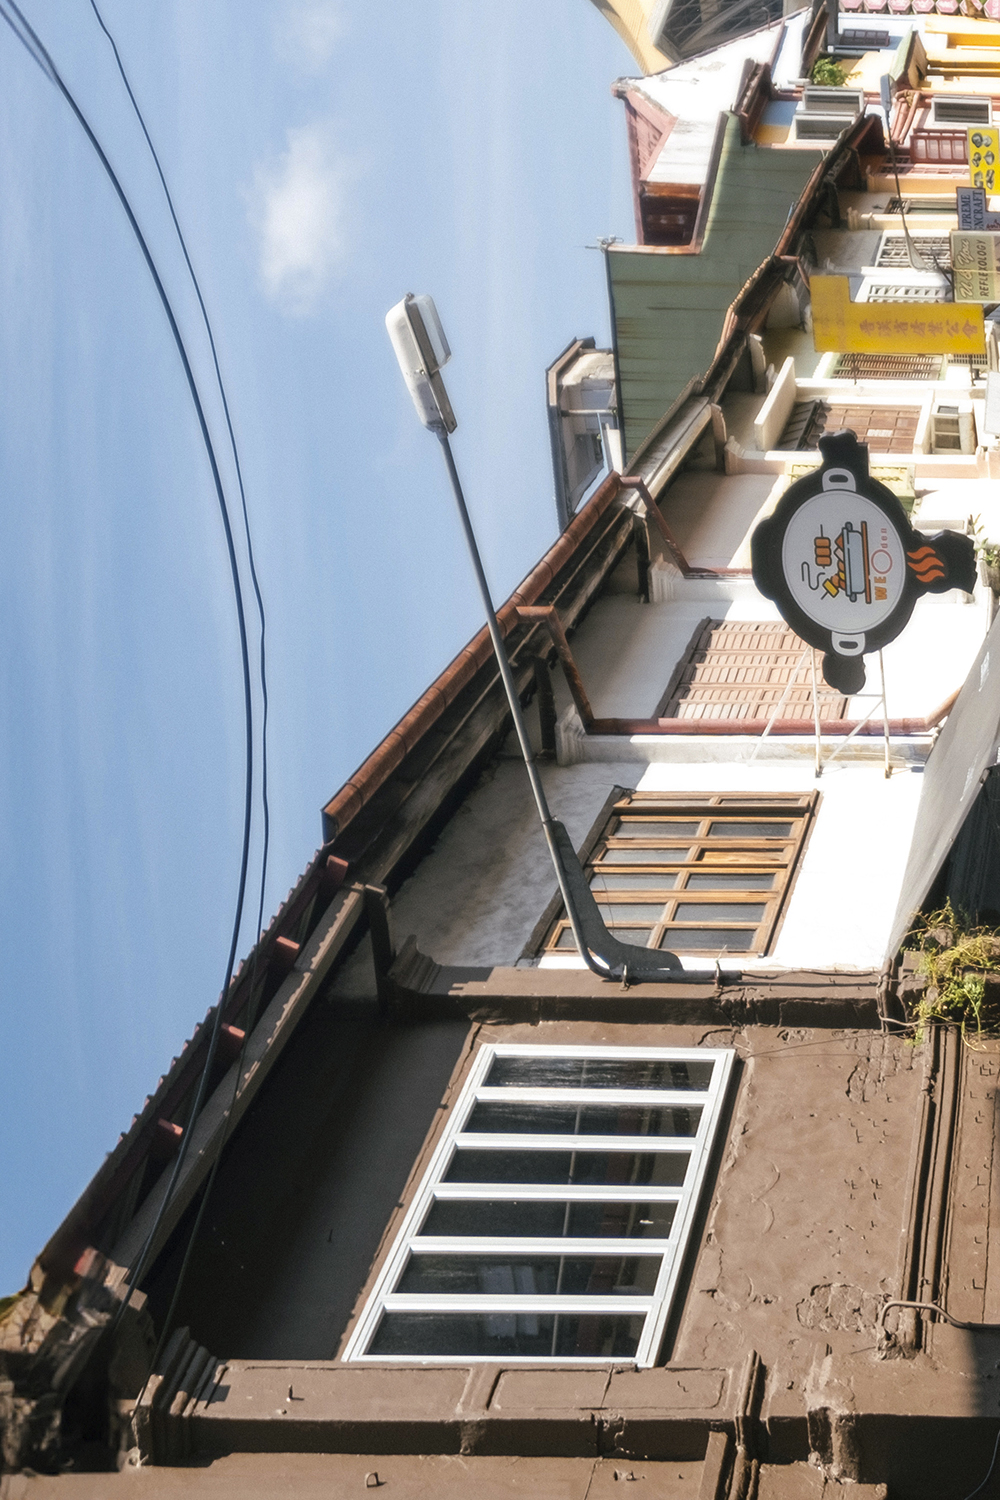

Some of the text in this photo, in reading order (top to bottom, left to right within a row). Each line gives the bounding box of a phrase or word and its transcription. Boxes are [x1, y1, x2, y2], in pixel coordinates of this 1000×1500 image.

[960, 194, 972, 230] UPREME
[957, 239, 974, 265] You
[975, 239, 989, 297] REFLEXOLOGY
[960, 282, 973, 298] U
[873, 576, 888, 601] WE
